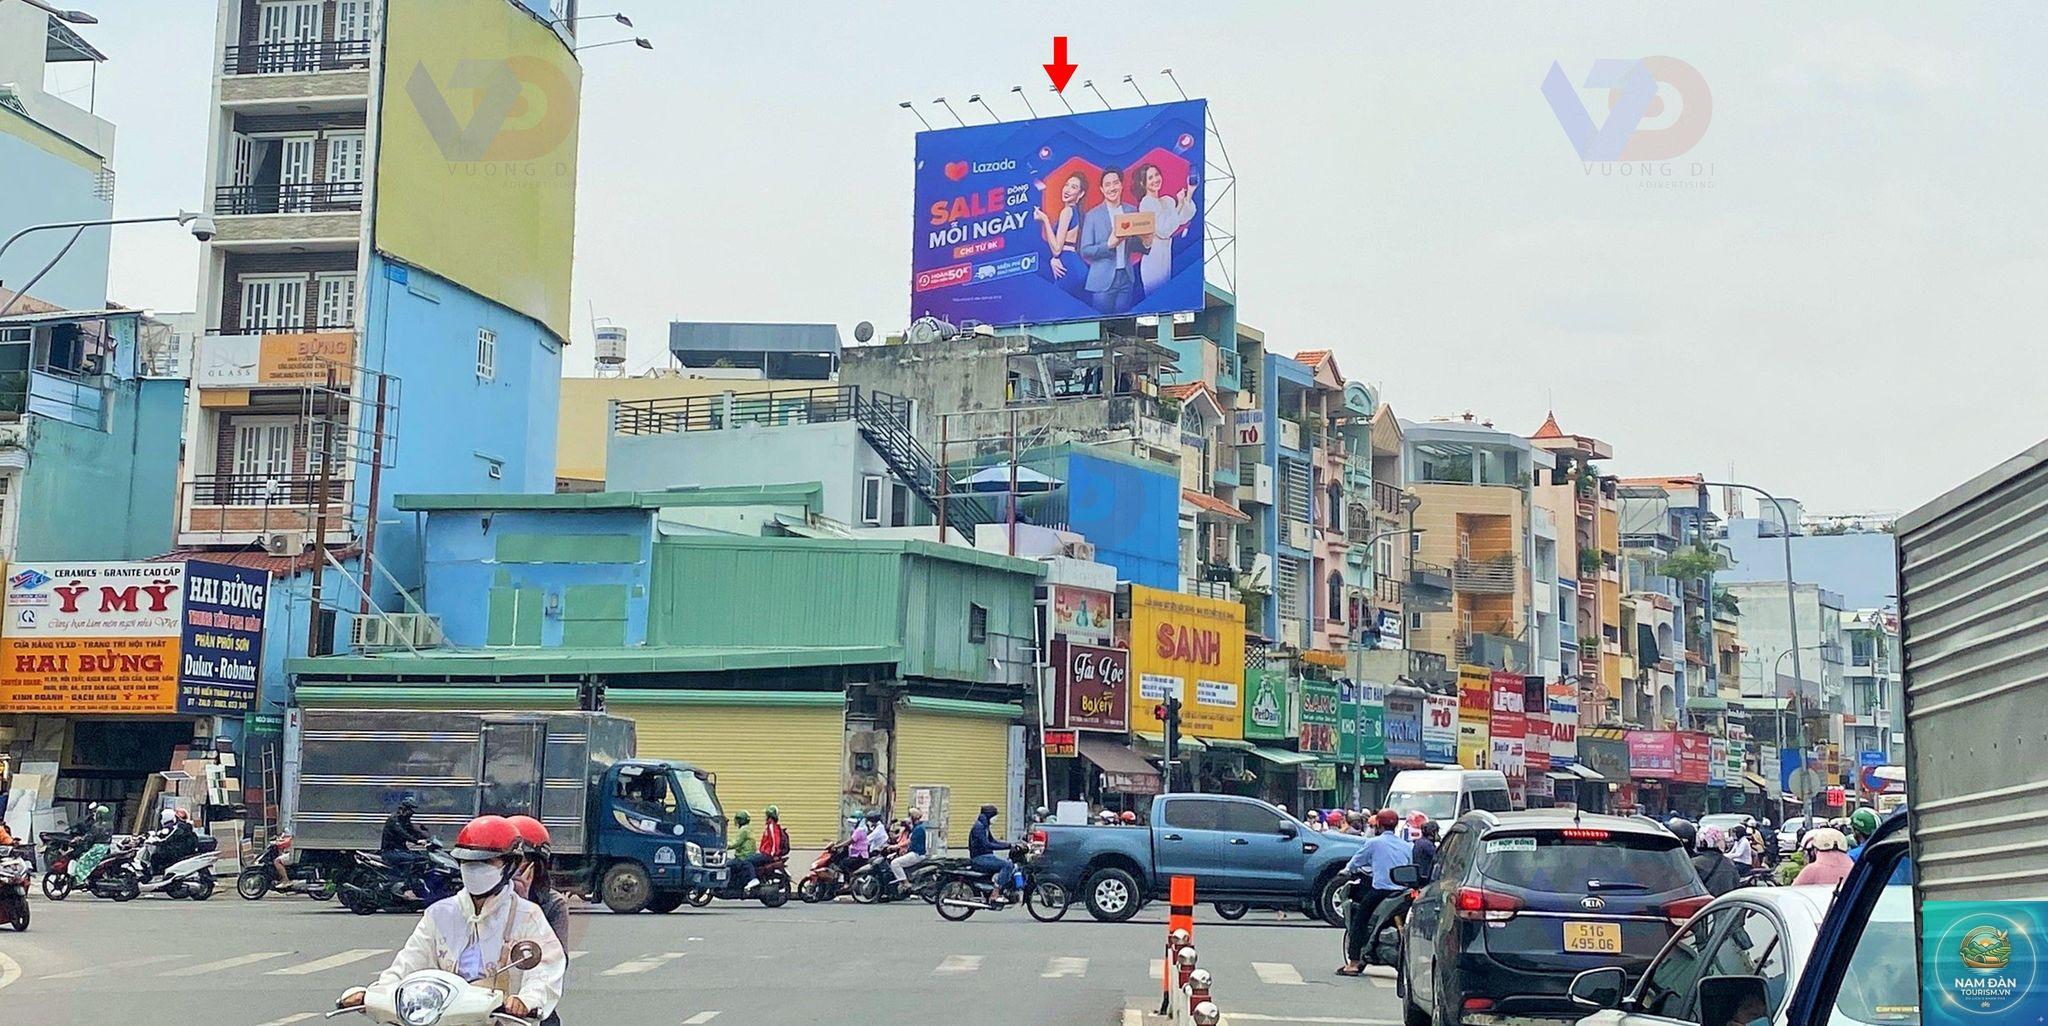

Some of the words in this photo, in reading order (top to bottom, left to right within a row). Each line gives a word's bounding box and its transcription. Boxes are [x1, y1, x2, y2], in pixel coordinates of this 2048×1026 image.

[972, 158, 1016, 173] Lazada
[930, 187, 1004, 225] SALE
[1007, 192, 1028, 206] GIÁ
[930, 222, 967, 248] MỖI
[973, 211, 1028, 238] NGÀY
[54, 569, 97, 577] CERAMICS
[164, 567, 181, 576] CẤP
[54, 580, 89, 612] Ý
[99, 580, 178, 612] MỸ
[190, 576, 218, 604] HAI
[222, 574, 263, 610] BỬNG
[195, 632, 215, 648] PHÂN
[216, 633, 234, 650] PHỐI
[235, 637, 250, 651] SƠN
[1156, 622, 1221, 666] SANH
[15, 654, 69, 672] HAI
[78, 649, 163, 672] BỬNG
[184, 654, 213, 677] Dulux
[220, 657, 256, 681] Robmix
[1074, 653, 1095, 682] Tài
[1099, 656, 1124, 688] Lộc
[1082, 695, 1114, 717] Bakery
[1341, 718, 1356, 734] KHO
[1580, 925, 1604, 937] 51G
[1571, 938, 1614, 950] 495.06
